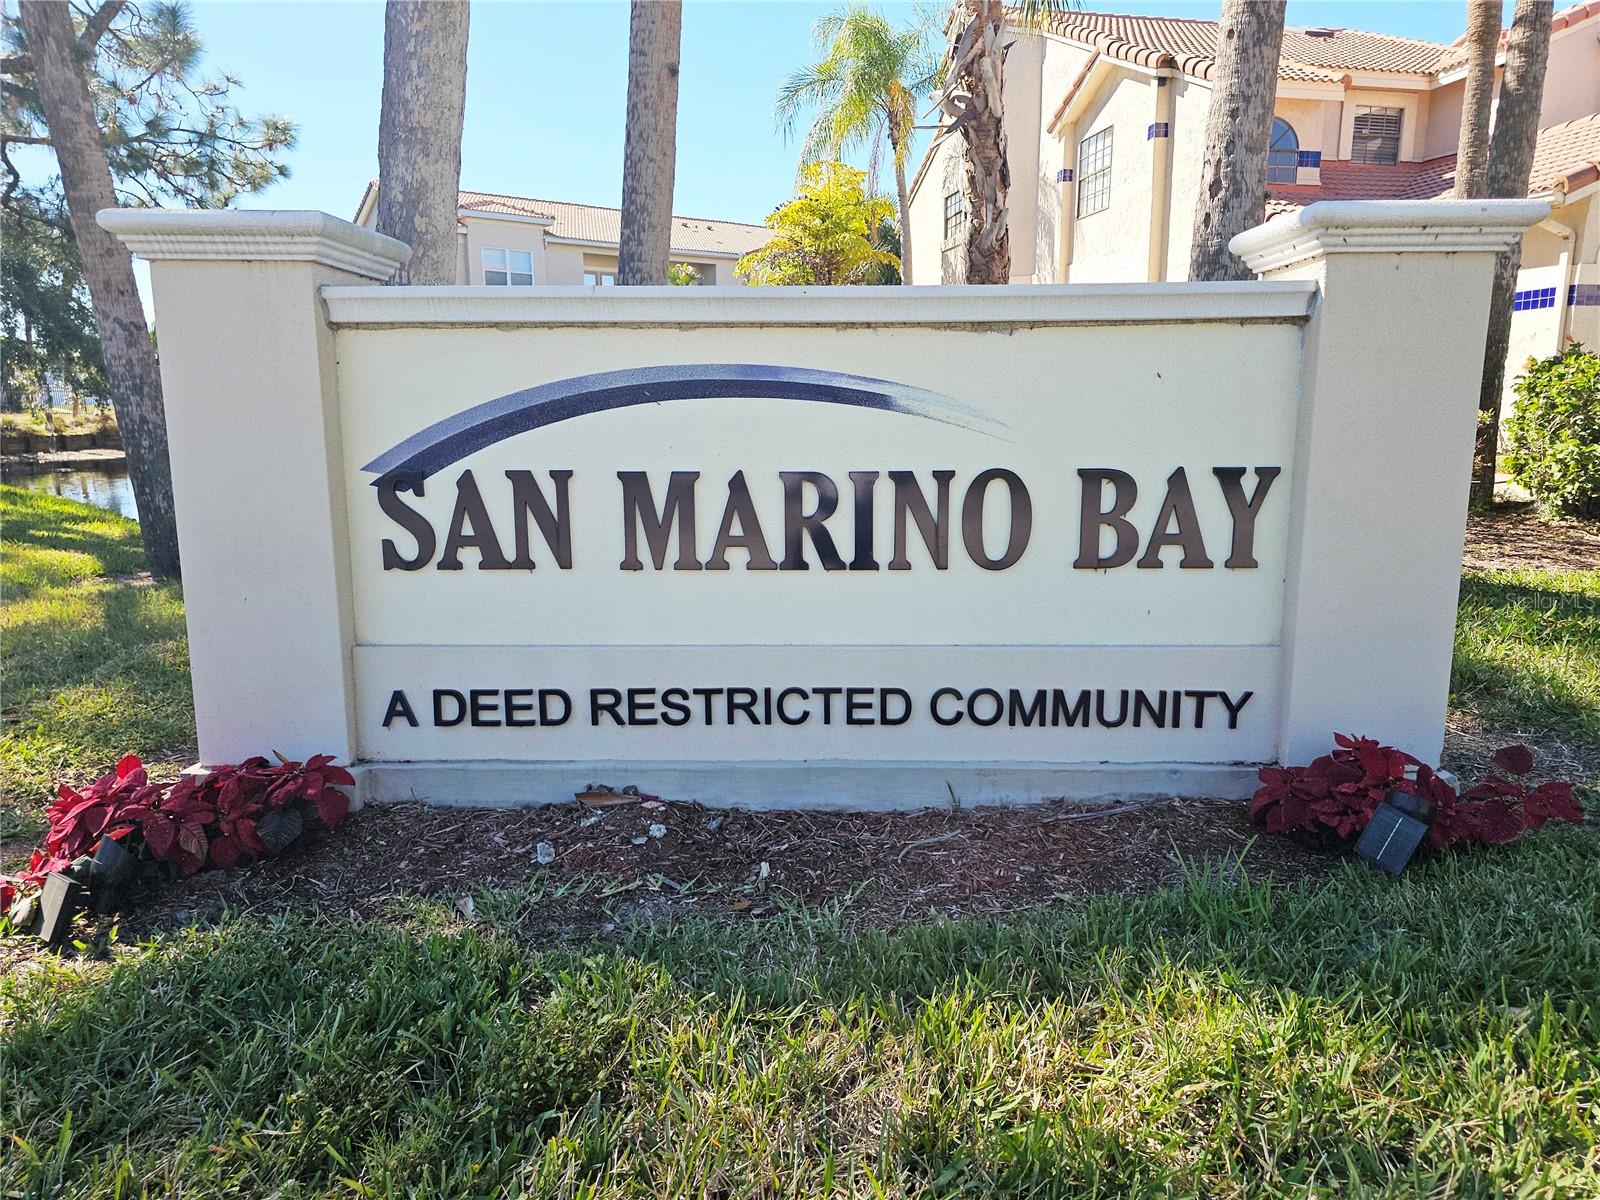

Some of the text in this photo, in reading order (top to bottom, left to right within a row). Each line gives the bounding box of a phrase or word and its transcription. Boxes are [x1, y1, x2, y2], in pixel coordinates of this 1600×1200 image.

[377, 466, 1281, 572] SAN MARINO BAY
[382, 687, 1254, 729] A DEED RESTRICTED COMMUNITY
